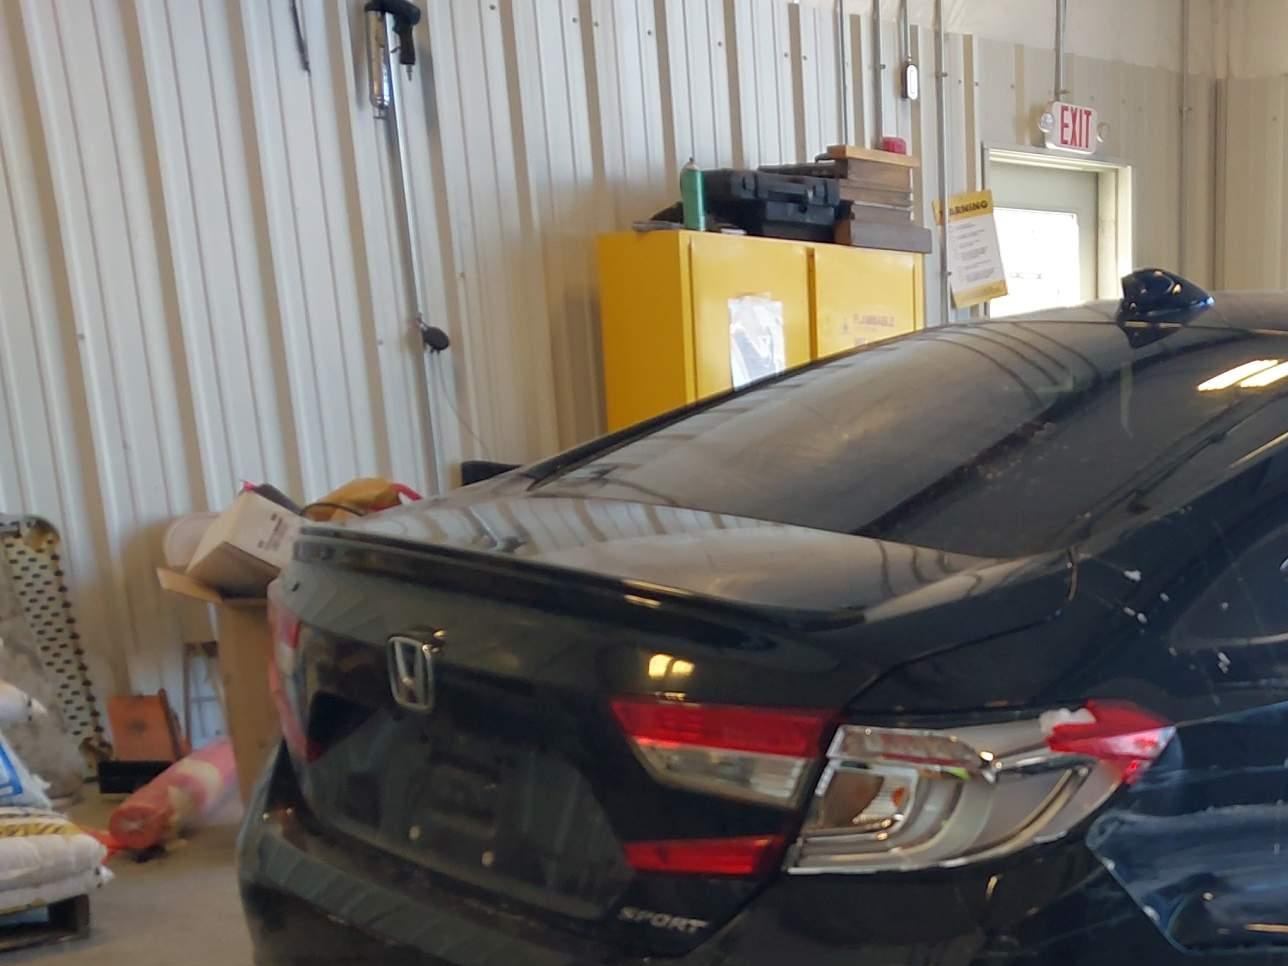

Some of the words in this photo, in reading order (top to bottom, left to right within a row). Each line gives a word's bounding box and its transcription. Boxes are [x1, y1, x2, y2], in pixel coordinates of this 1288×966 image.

[1060, 105, 1092, 149] EXIT
[939, 200, 989, 217] ARNING
[618, 907, 709, 933] SPORT
